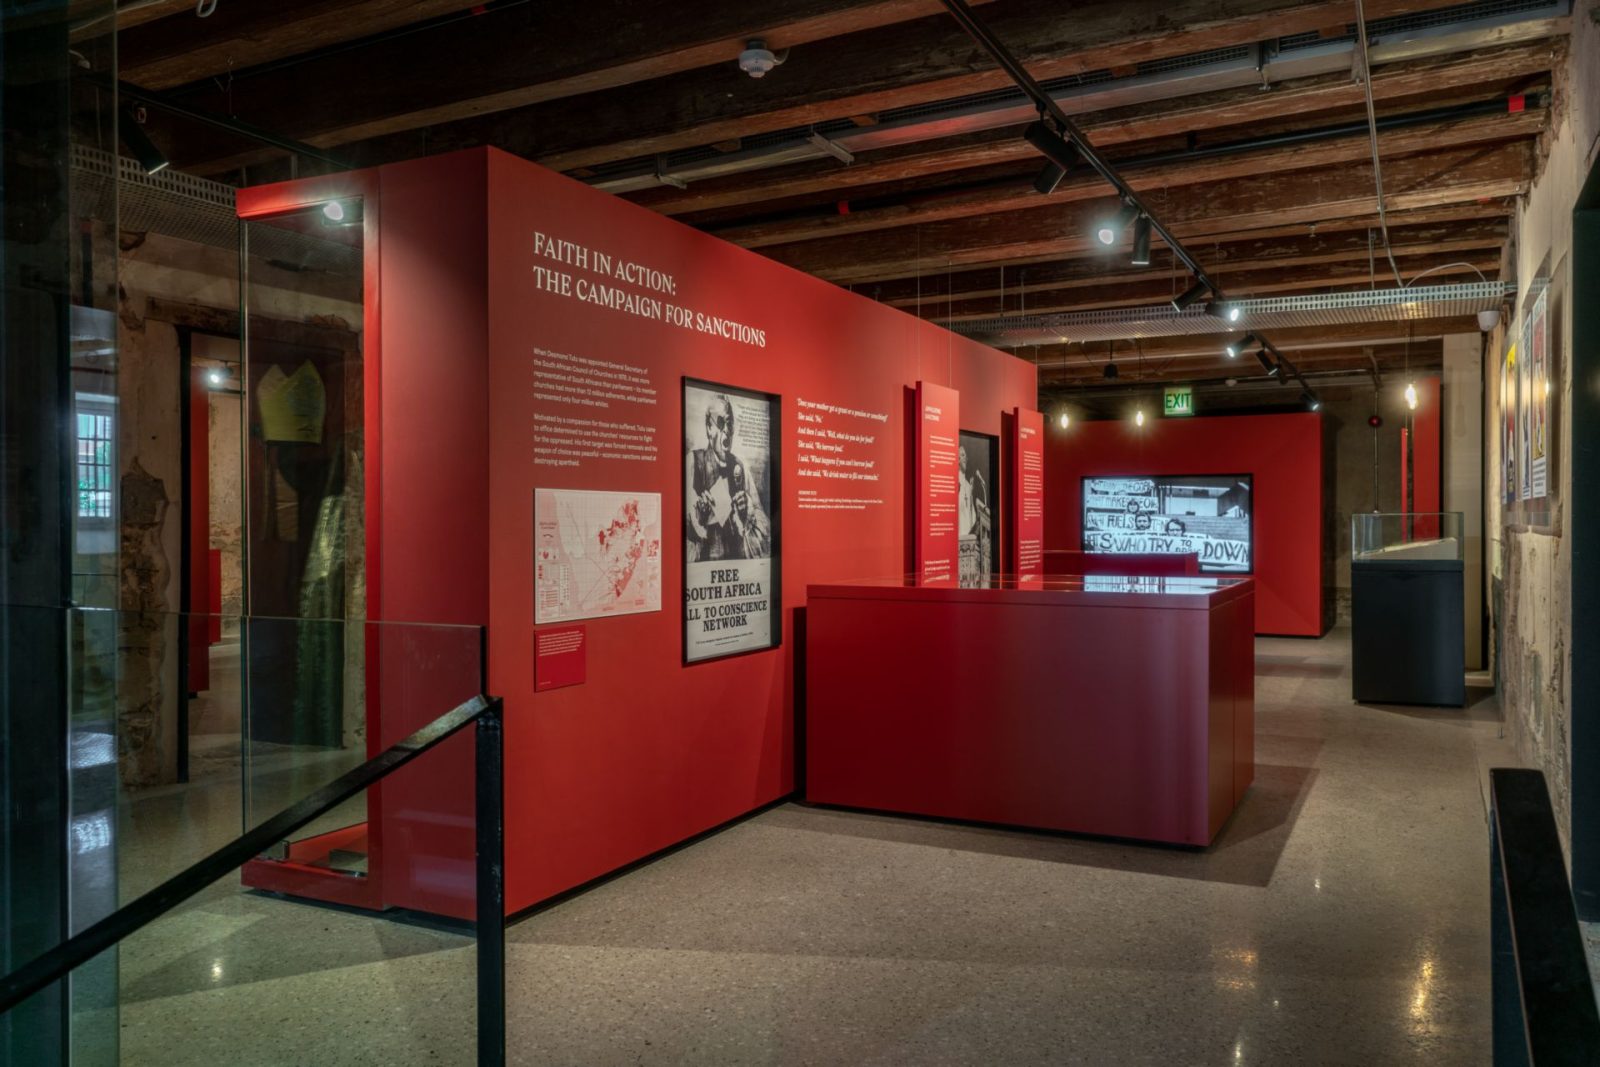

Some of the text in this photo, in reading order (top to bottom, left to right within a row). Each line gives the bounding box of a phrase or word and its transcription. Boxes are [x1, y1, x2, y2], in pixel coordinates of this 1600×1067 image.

[534, 232, 676, 296] FAITH IN ACTION:
[533, 266, 766, 348] THE CAMPAIGN FOR SANCTIONS
[1166, 394, 1191, 408] EXIT
[1108, 514, 1134, 530] FUELS
[1114, 538, 1146, 552] WHO
[1148, 538, 1174, 552] TRY
[1180, 540, 1192, 548] TO
[1202, 541, 1248, 563] DOWN
[711, 569, 739, 583] FREE
[686, 582, 762, 602] SOUTH AFRICA
[686, 600, 767, 621] LL TO CONSCIENCE
[703, 615, 747, 632] NETWORK
